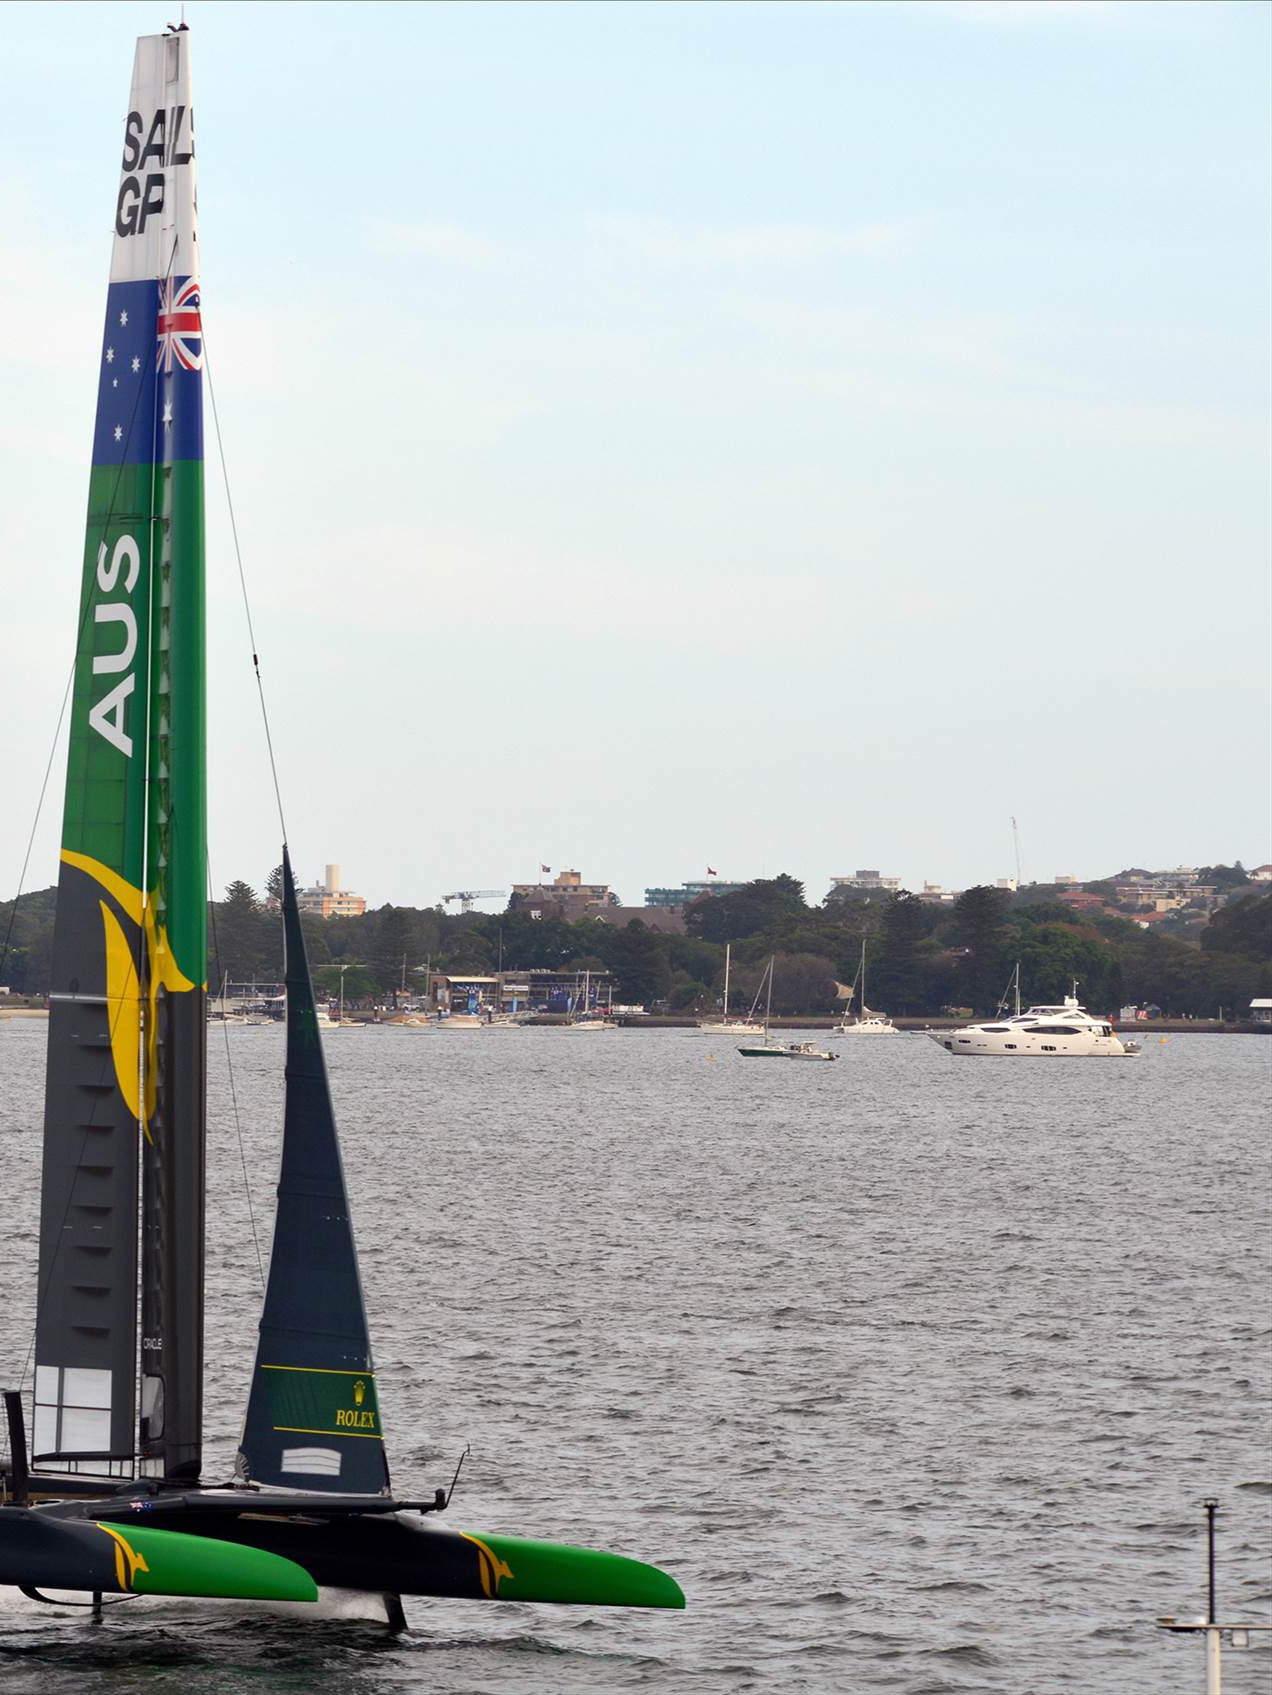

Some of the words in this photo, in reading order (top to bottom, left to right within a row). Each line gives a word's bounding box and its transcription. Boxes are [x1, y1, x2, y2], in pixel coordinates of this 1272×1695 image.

[122, 105, 193, 172] SAIL
[115, 173, 165, 238] GP
[89, 534, 140, 758] AUS
[336, 1409, 375, 1428] ROLEX
